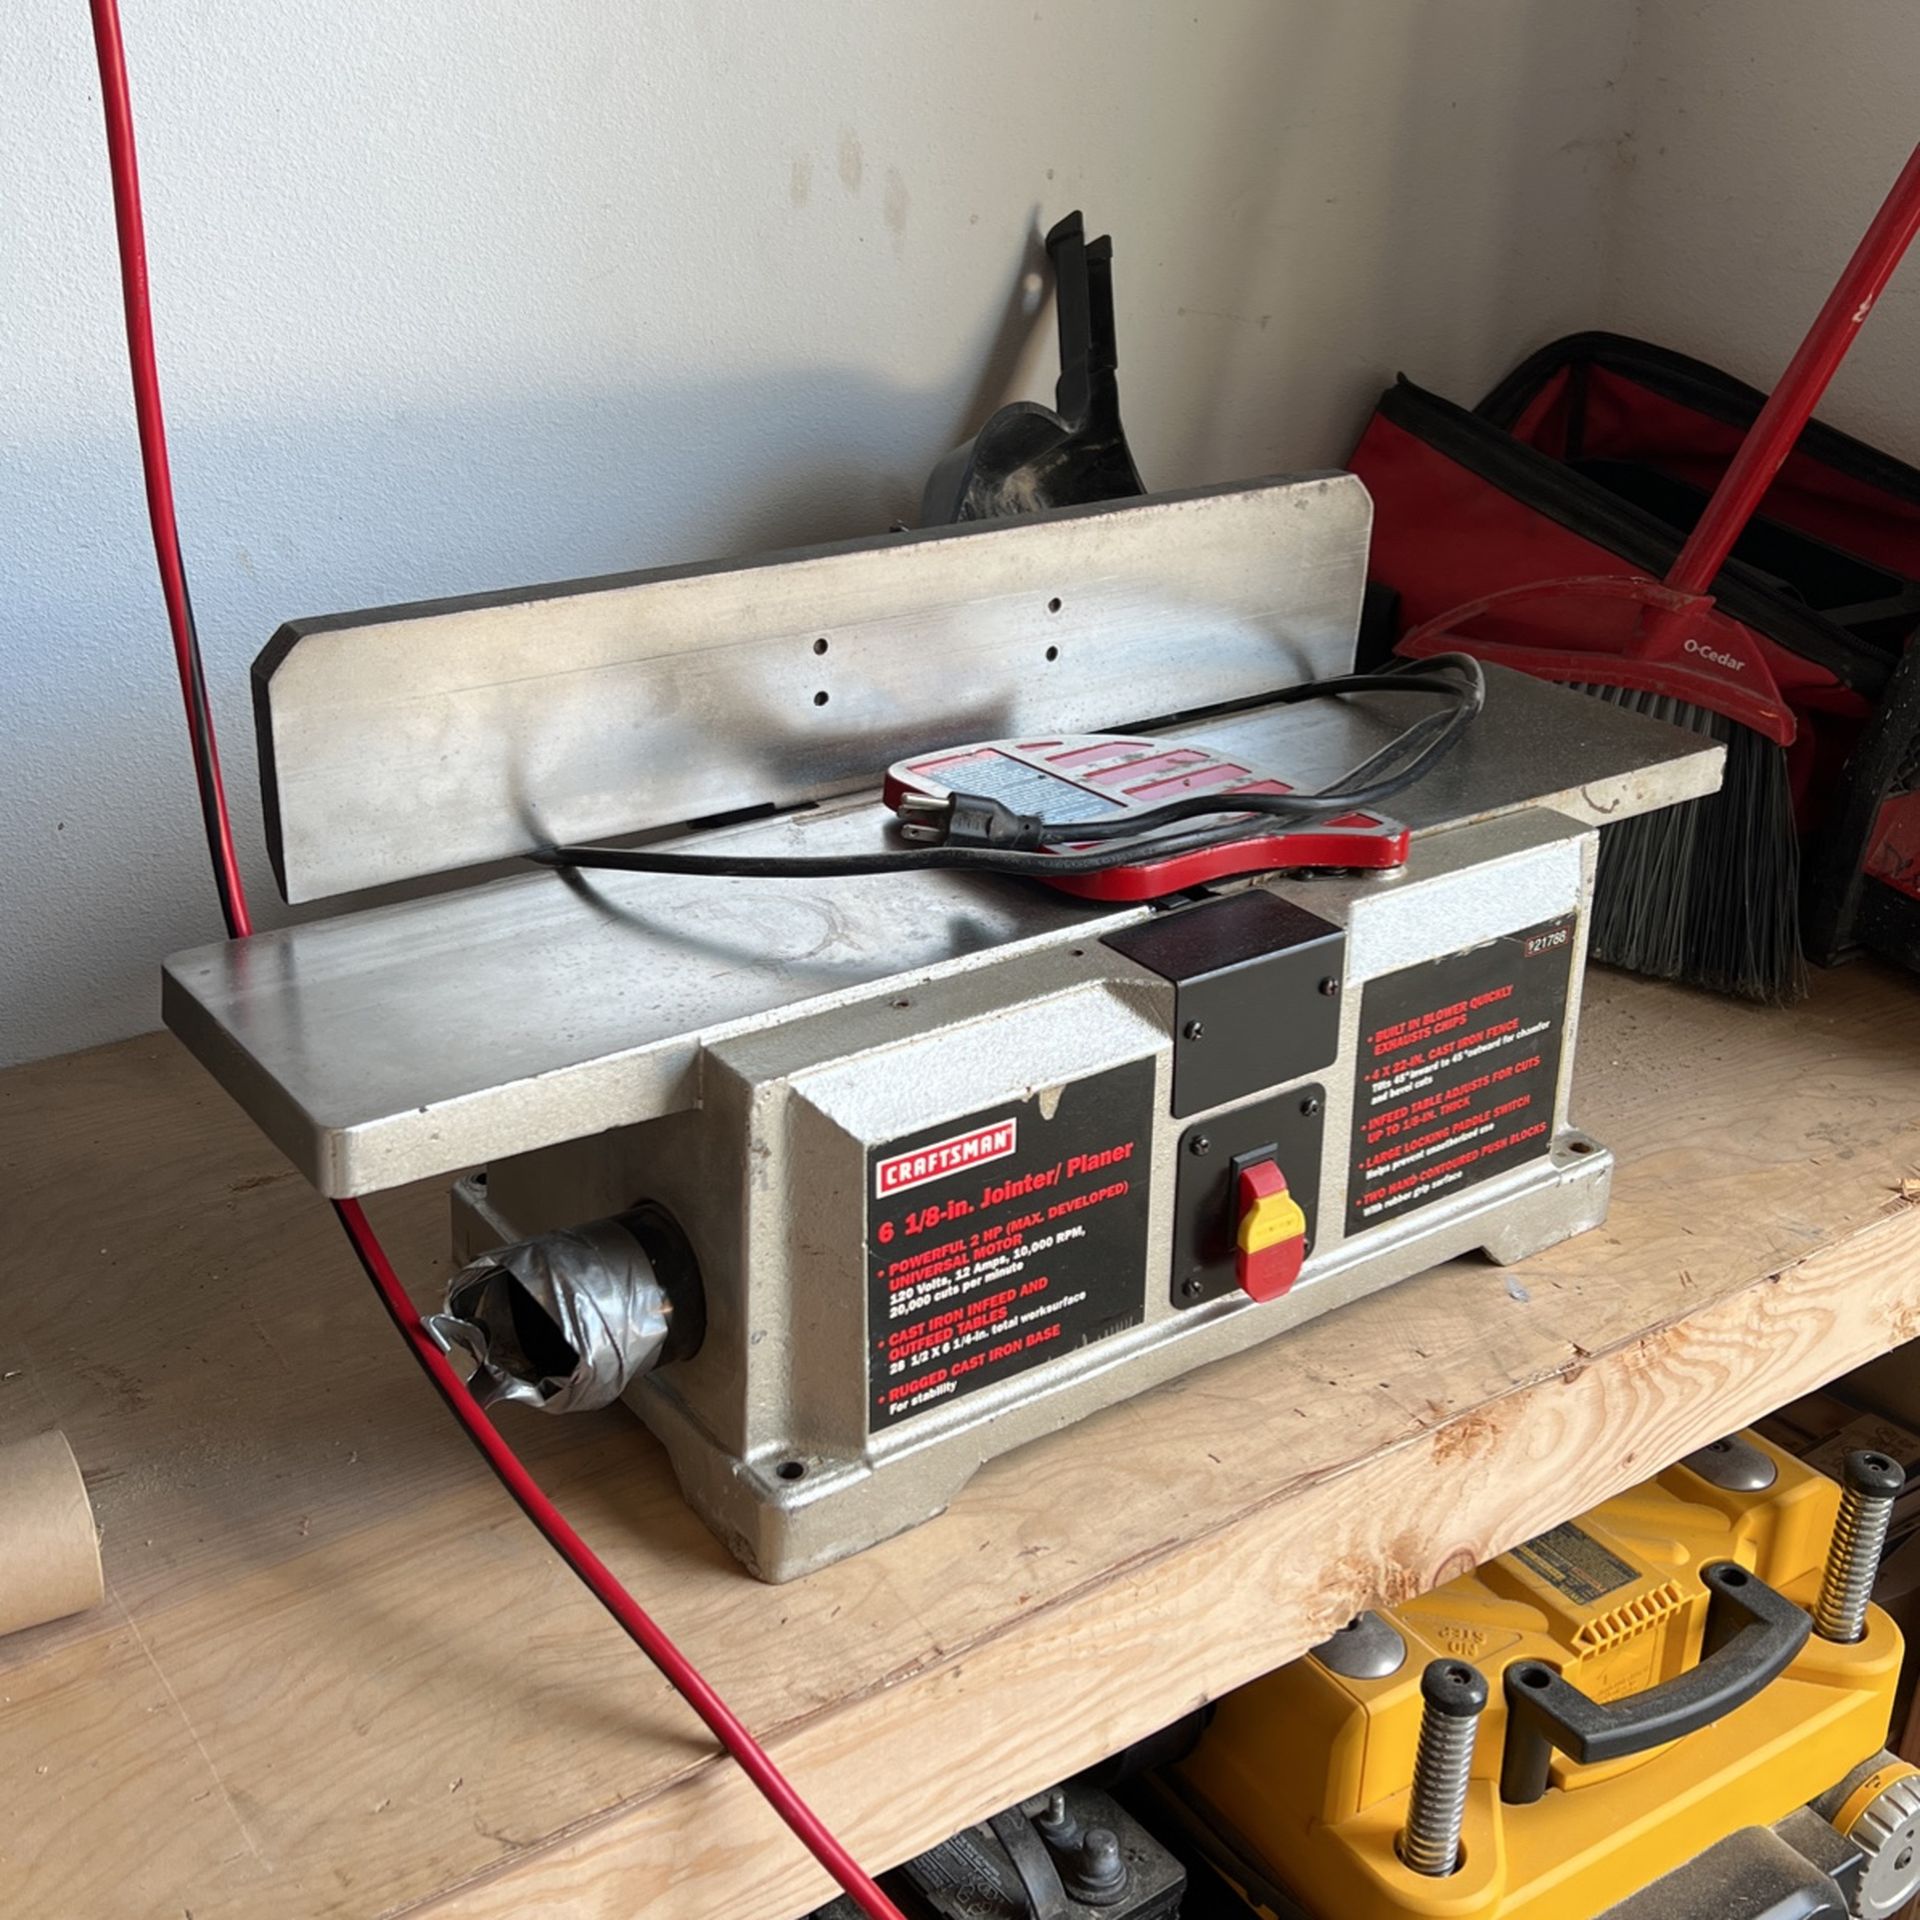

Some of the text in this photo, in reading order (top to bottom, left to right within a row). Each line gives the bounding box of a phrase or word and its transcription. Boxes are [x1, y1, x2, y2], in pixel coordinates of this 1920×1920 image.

[1684, 639, 1746, 671] O-Cedar
[1374, 1013, 1467, 1056] EXHAUSTS CHIPS
[1375, 1022, 1406, 1043] BUILT
[1422, 1001, 1468, 1026] BLOWER
[1469, 984, 1514, 1010] QUICKLY
[1428, 1041, 1456, 1060] CAST
[1457, 1031, 1484, 1050] IRON
[1486, 1017, 1519, 1039] FENCE
[1367, 1129, 1384, 1144] UP
[1386, 1123, 1400, 1136] TO
[1440, 1095, 1470, 1115] THICK
[1368, 1055, 1541, 1130] INFEED TABLE ADJUSTS FOR CUTS
[886, 1127, 1008, 1185] CRAFTSMAN
[1365, 1094, 1532, 1168] LARGE LOCKING PADDLE SWITCH
[1364, 1188, 1386, 1204] TWO
[1481, 1137, 1509, 1157] PUSH
[1509, 1121, 1547, 1145] BLOCKS
[878, 1142, 1134, 1243] 6 1/8-in. Jointer/ Planer
[888, 1180, 1129, 1277] POWERFUL 2 HP (MAX. DEVELOPED)
[889, 1233, 1023, 1292] UNIVERSAL MOTOR
[889, 1261, 1024, 1319] 20,000 cuts per minute
[890, 1225, 1086, 1305] 120 Volts, 12 Amps, 10,000 RPM,
[889, 1276, 1048, 1346] CAST IRON INFEED AND
[889, 1359, 906, 1375] 28
[911, 1350, 929, 1367] 1/2
[931, 1345, 941, 1359] X
[941, 1341, 951, 1354] 6
[991, 1315, 1019, 1335] total
[1020, 1291, 1086, 1323] worksurface
[889, 1306, 1008, 1361] OUTFEED TABLES
[889, 1323, 1061, 1402] RUGGED CAST IRON BASE
[889, 1380, 958, 1415] For stability
